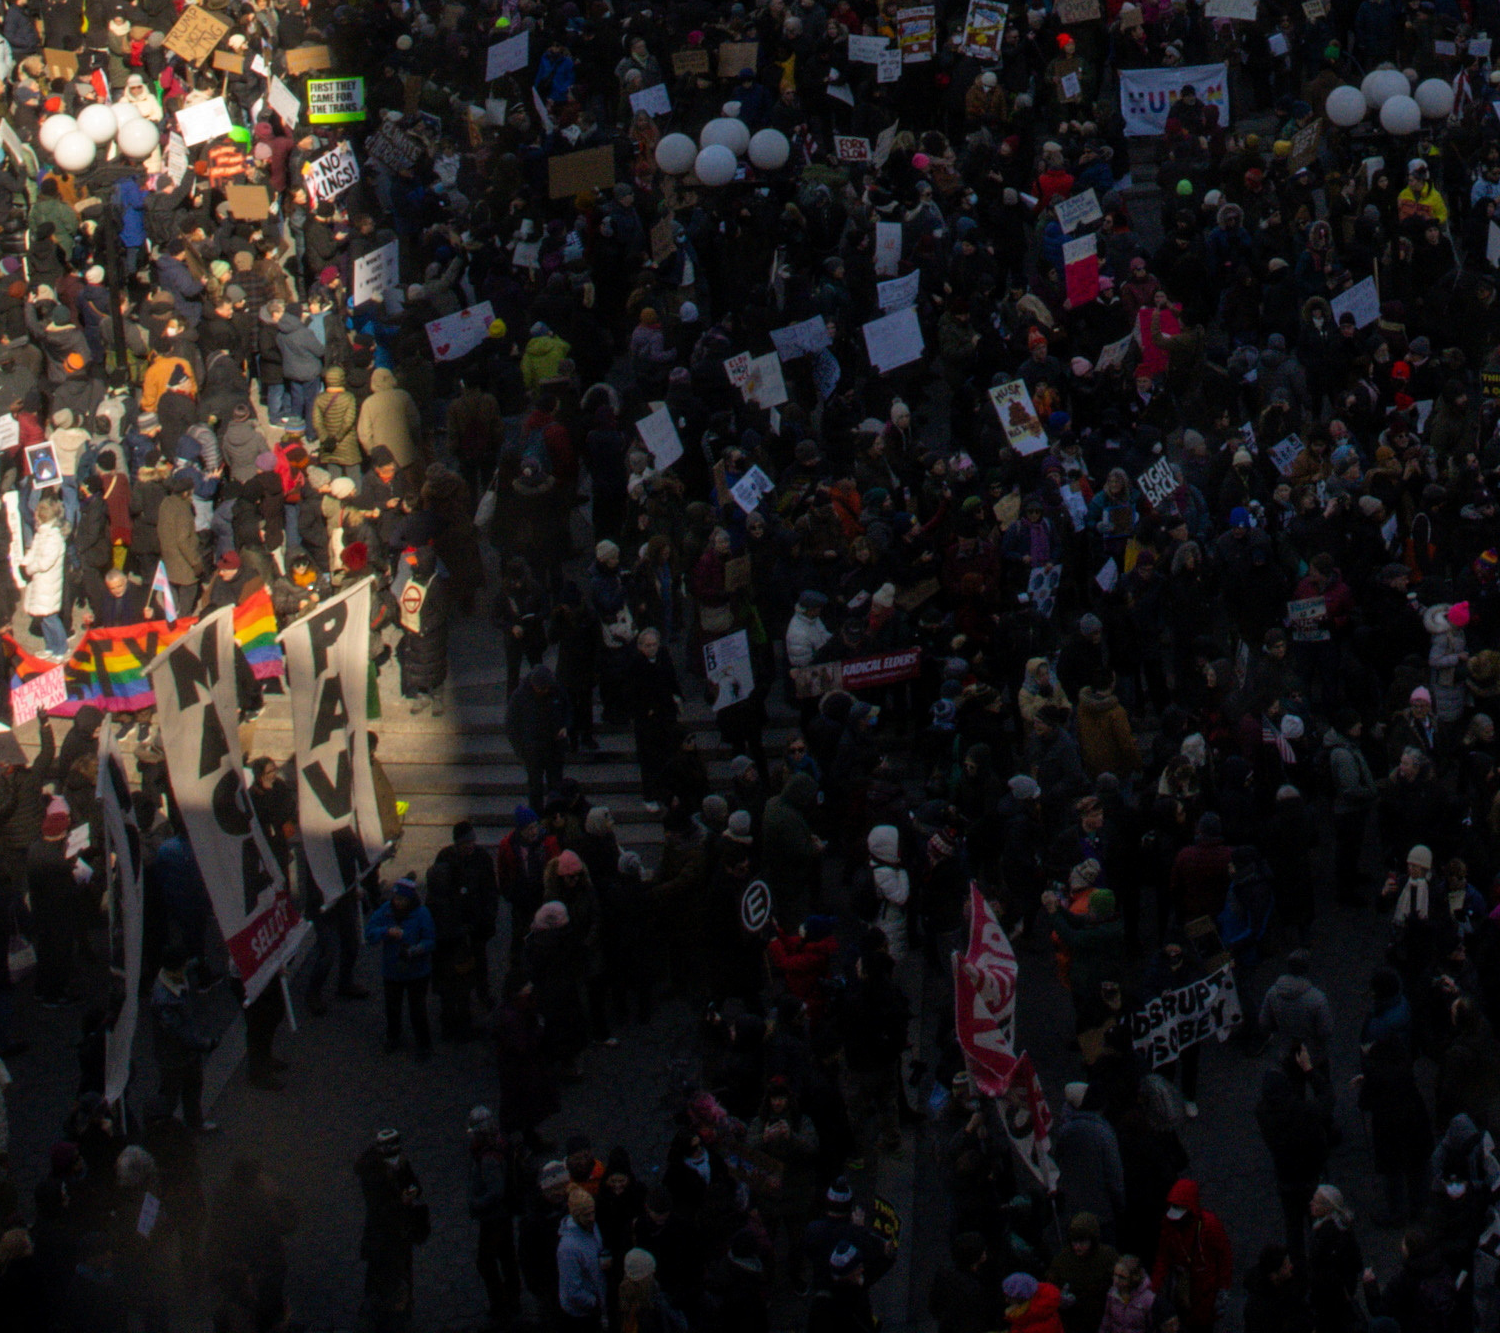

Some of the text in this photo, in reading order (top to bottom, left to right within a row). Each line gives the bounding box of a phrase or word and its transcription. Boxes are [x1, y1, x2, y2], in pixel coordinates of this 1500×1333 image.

[165, 8, 199, 45] TRUMP
[310, 81, 356, 92] FIRST THEY
[311, 92, 353, 102] CAME FOR
[311, 102, 357, 114] THE TRANS
[318, 152, 341, 176] NO
[316, 161, 358, 201] KINGS!
[1483, 386, 1490, 394] A
[1148, 474, 1180, 507] BACK
[842, 654, 918, 677] RADICAL ELDERS
[15, 697, 30, 713] IS
